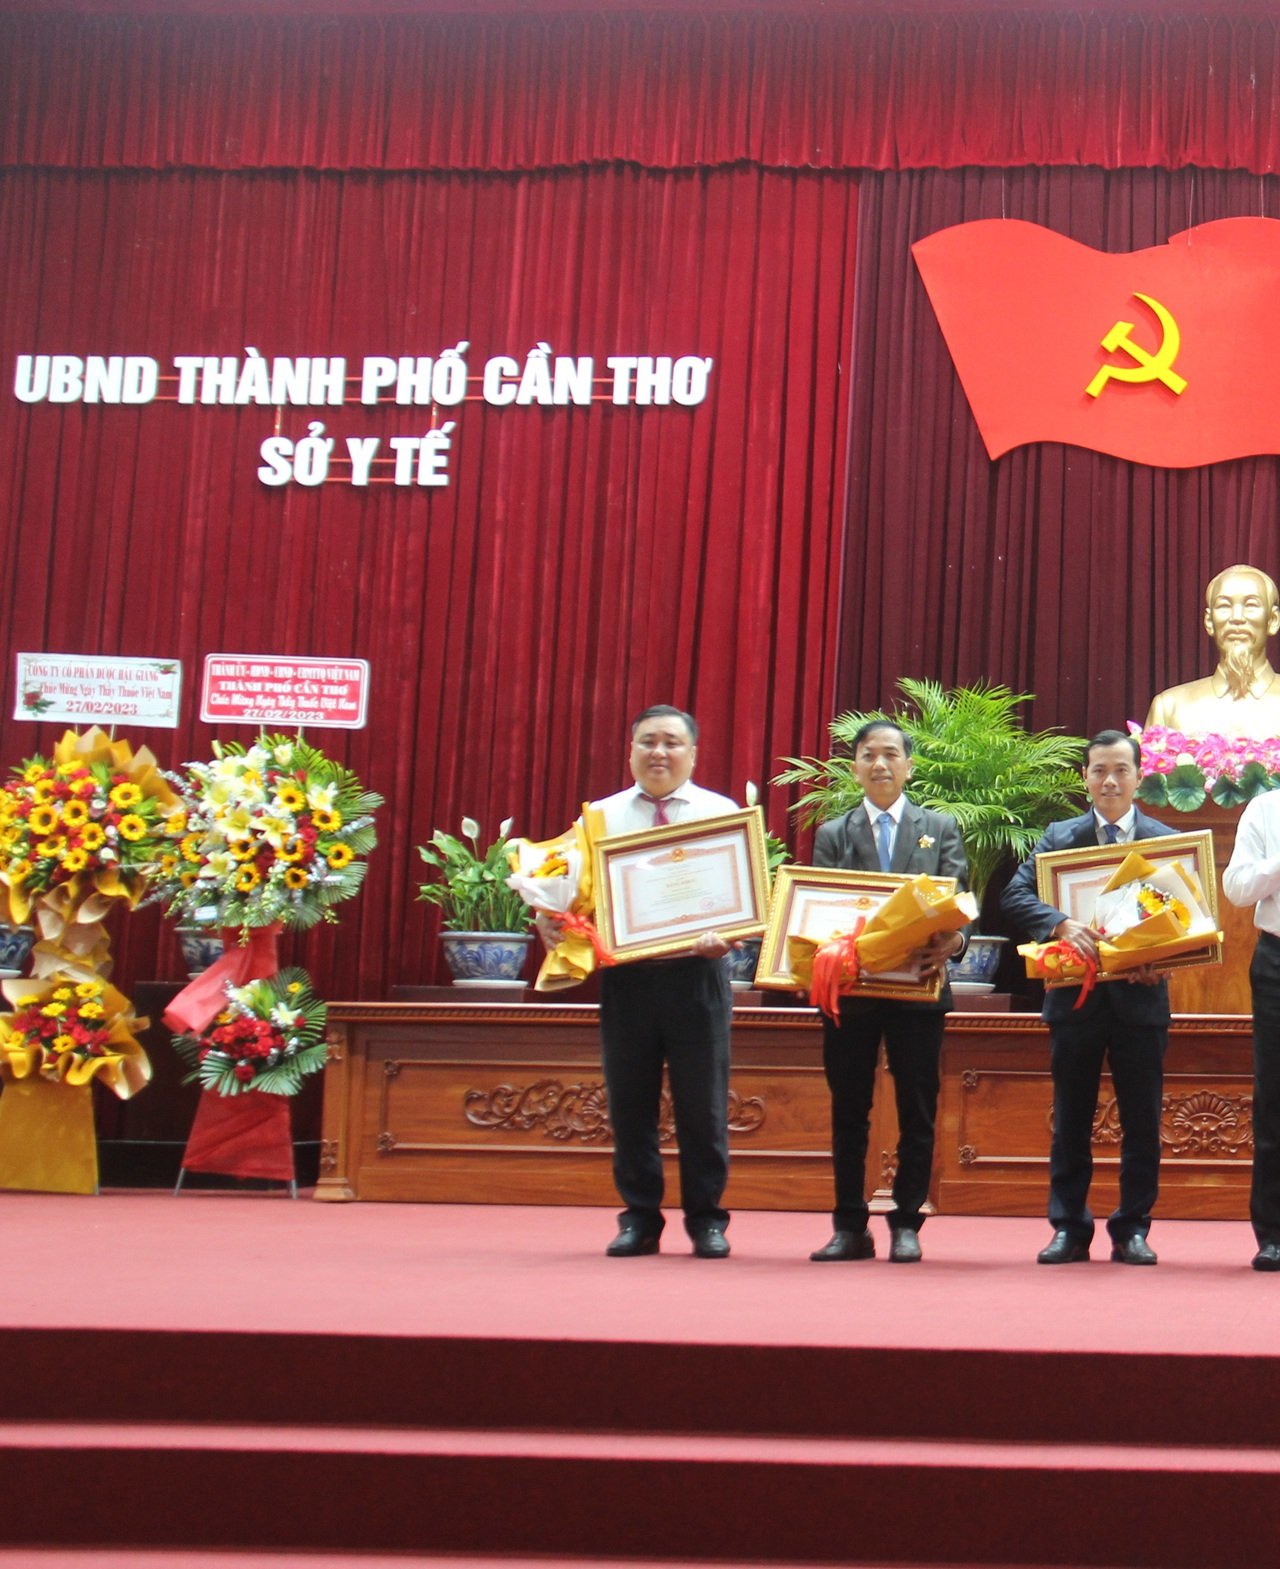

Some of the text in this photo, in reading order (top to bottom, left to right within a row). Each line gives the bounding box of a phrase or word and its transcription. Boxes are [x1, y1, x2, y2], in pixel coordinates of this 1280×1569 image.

[13, 340, 713, 406] UBND THÀNH PHỐ CẦN THƠ
[257, 421, 456, 487] SỞ Y TẾ
[66, 700, 138, 716] 27/02/2023
